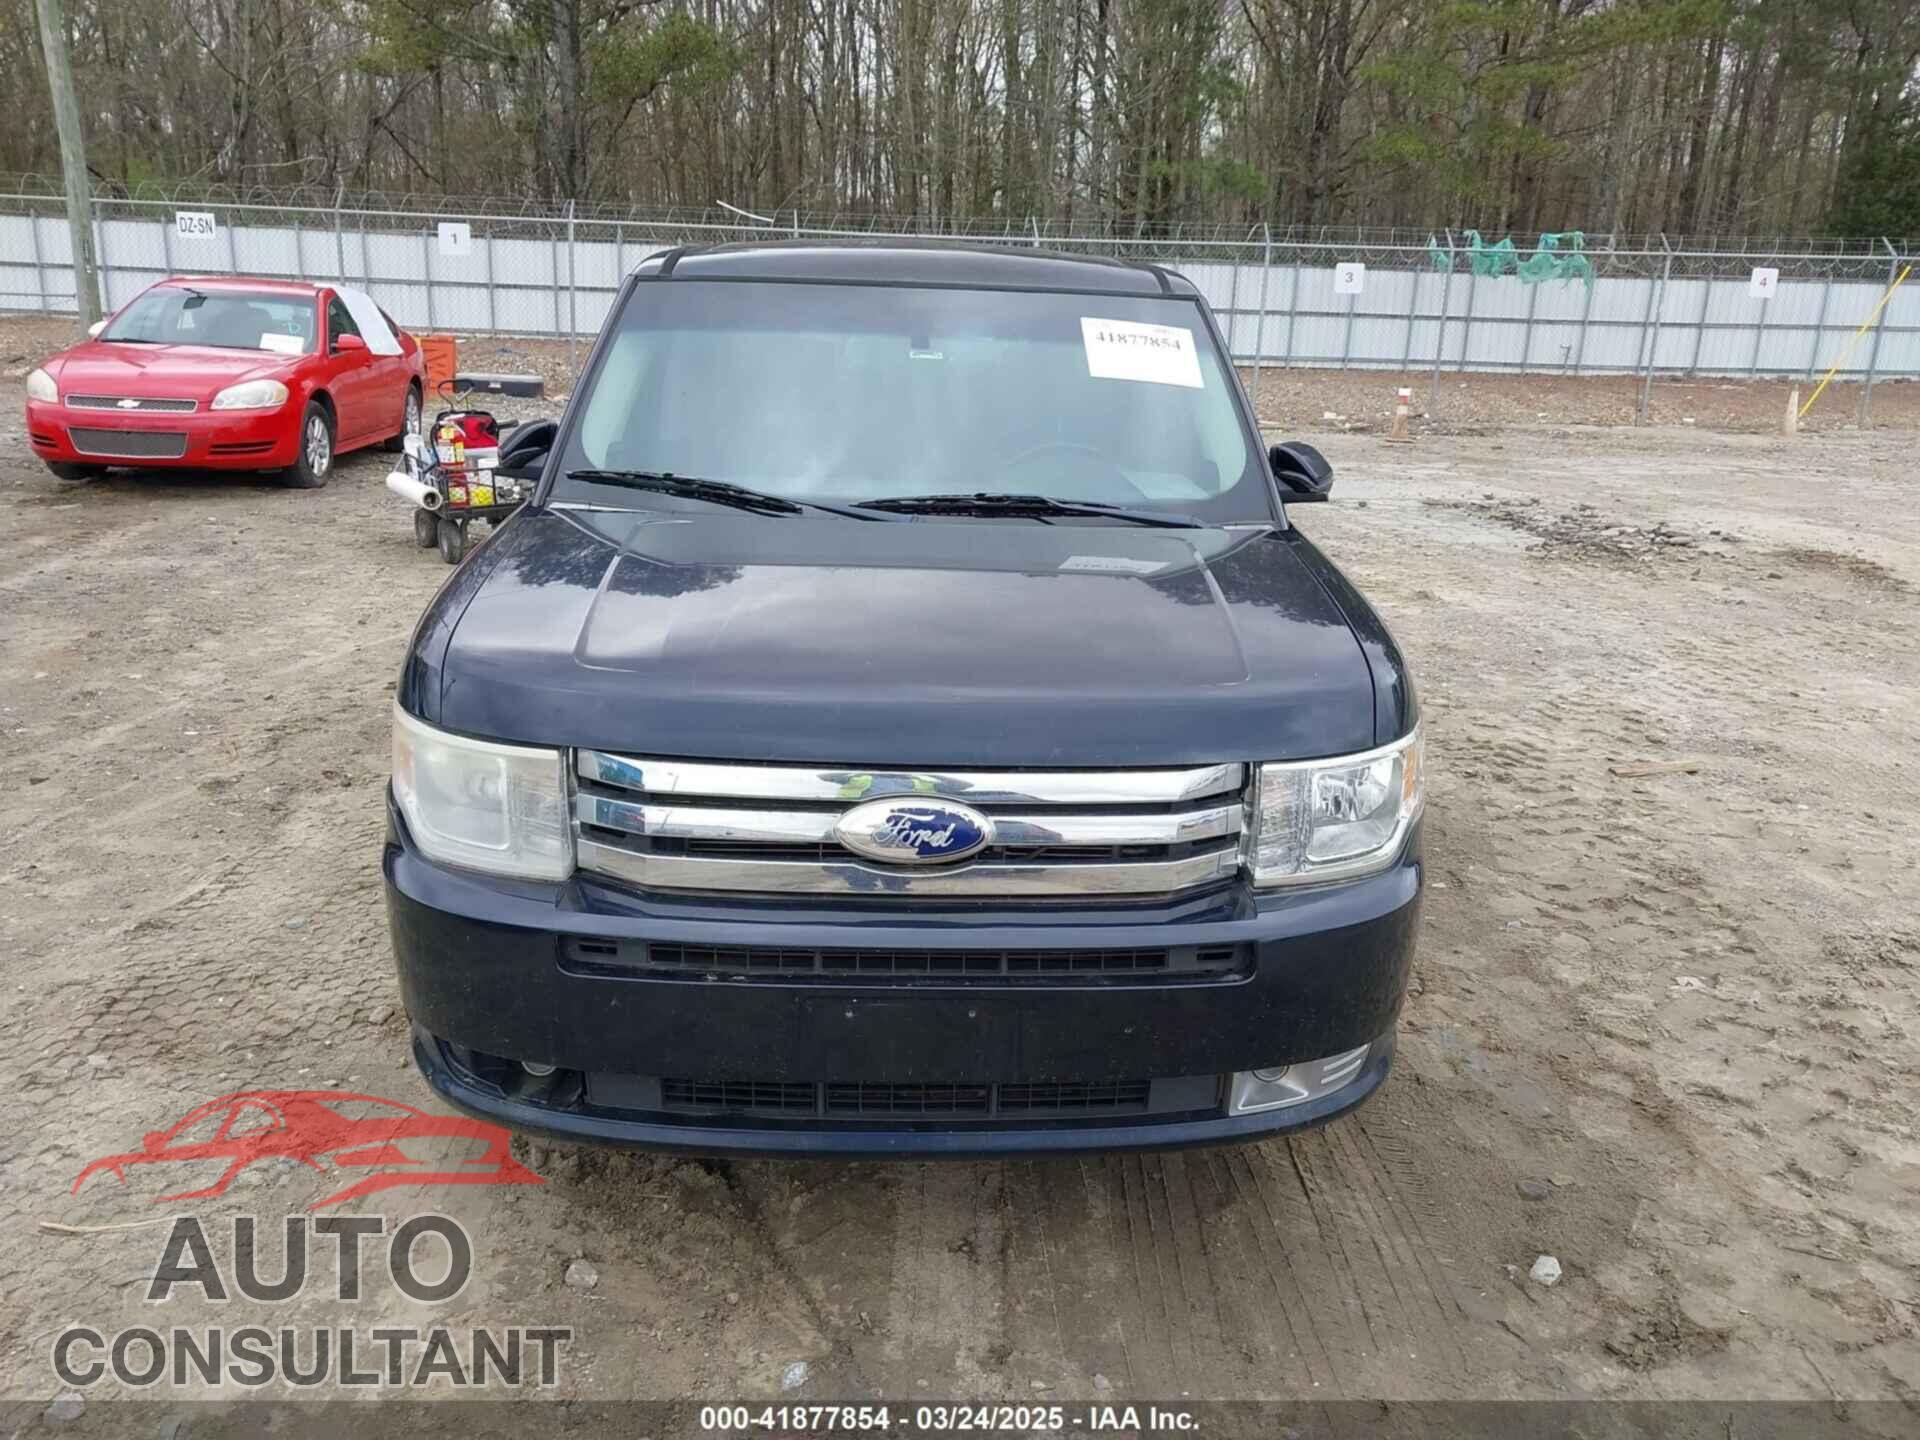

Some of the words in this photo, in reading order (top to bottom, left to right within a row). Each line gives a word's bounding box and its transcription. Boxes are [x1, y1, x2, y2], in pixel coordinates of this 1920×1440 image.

[179, 216, 214, 234] DZ-SN
[1344, 271, 1354, 284] 3
[1759, 277, 1768, 288] 4
[1095, 331, 1182, 351] 41877854
[872, 812, 954, 847] Ford
